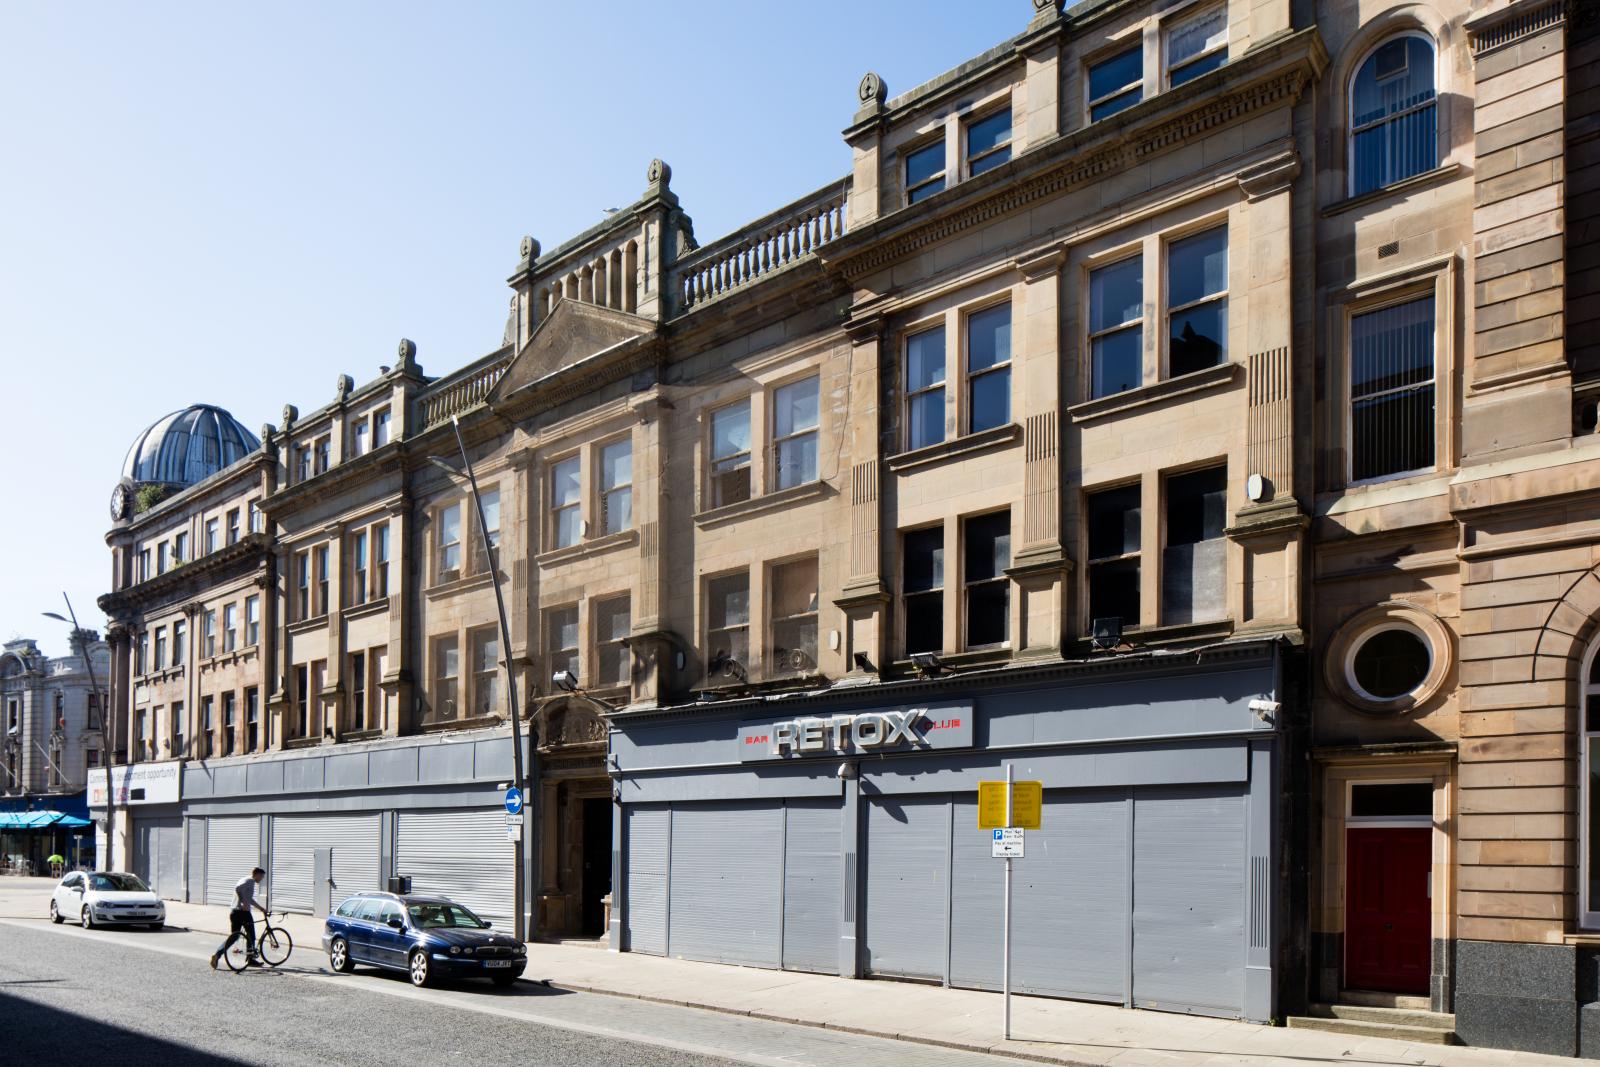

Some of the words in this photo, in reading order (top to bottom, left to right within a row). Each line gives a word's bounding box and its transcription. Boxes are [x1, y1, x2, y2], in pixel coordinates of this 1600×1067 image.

[924, 719, 961, 730] CLUB
[773, 708, 928, 755] RETOX
[745, 735, 769, 745] BAR
[147, 768, 176, 781] opportunity
[995, 830, 1002, 839] P
